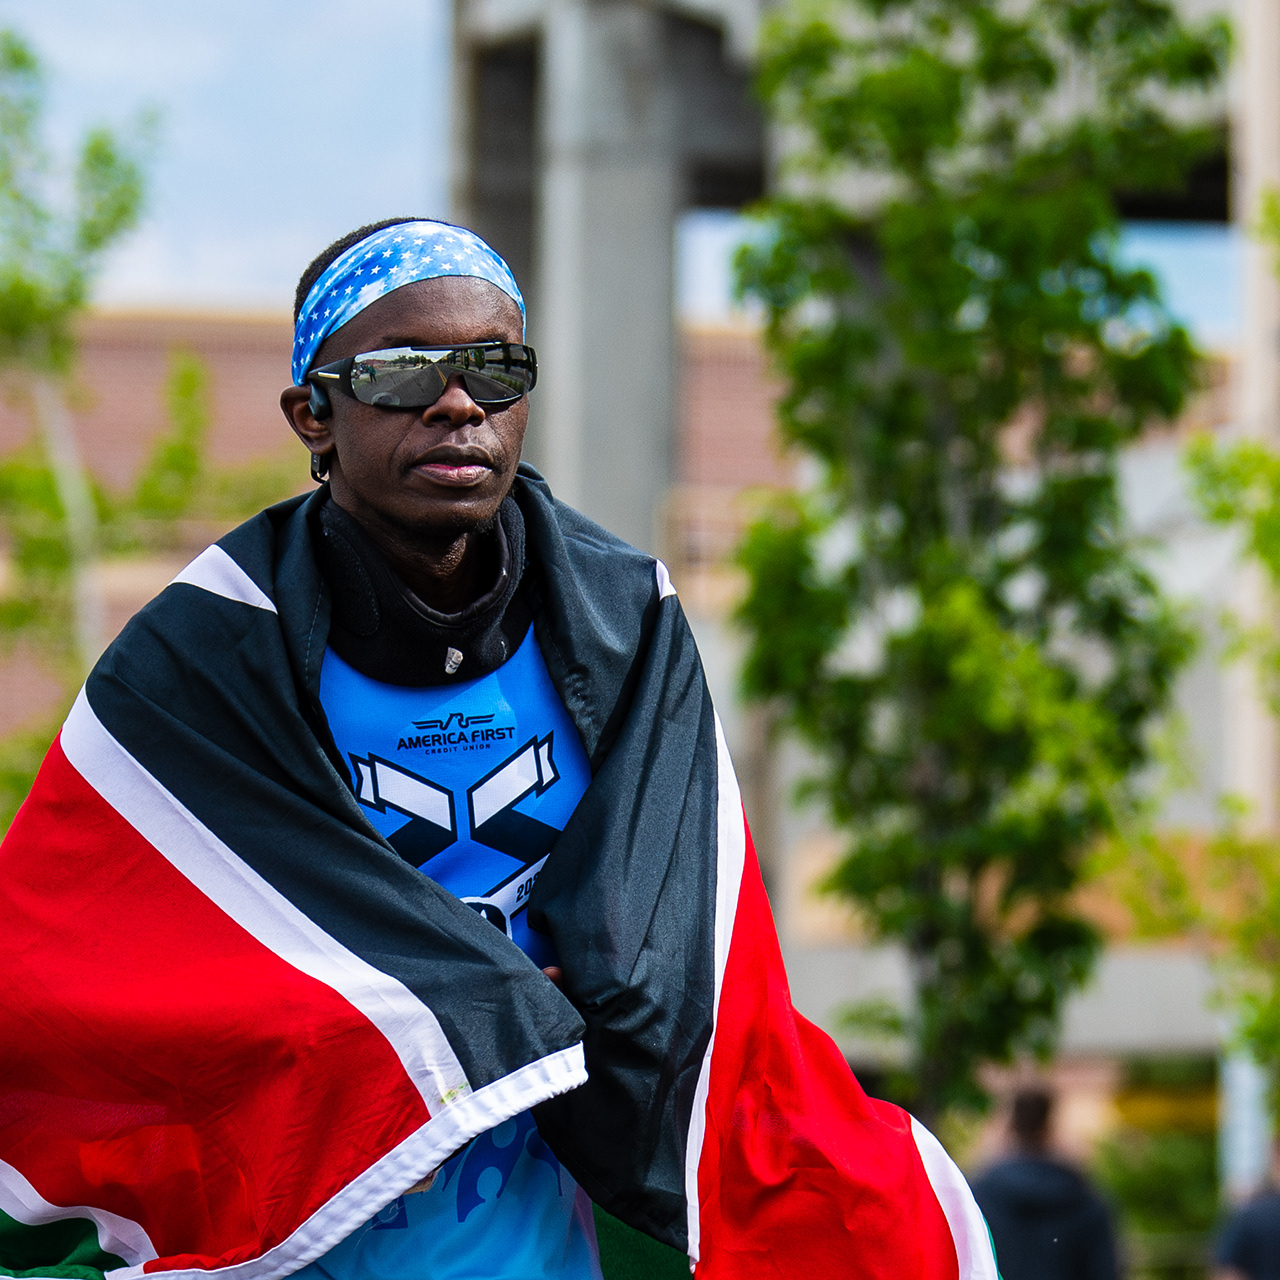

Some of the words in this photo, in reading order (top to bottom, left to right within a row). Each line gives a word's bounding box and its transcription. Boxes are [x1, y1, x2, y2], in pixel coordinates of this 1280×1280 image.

[396, 731, 469, 751] AMERICA
[471, 726, 516, 743] FIRST
[424, 746, 458, 755] CREDIT
[463, 743, 491, 752] UNION
